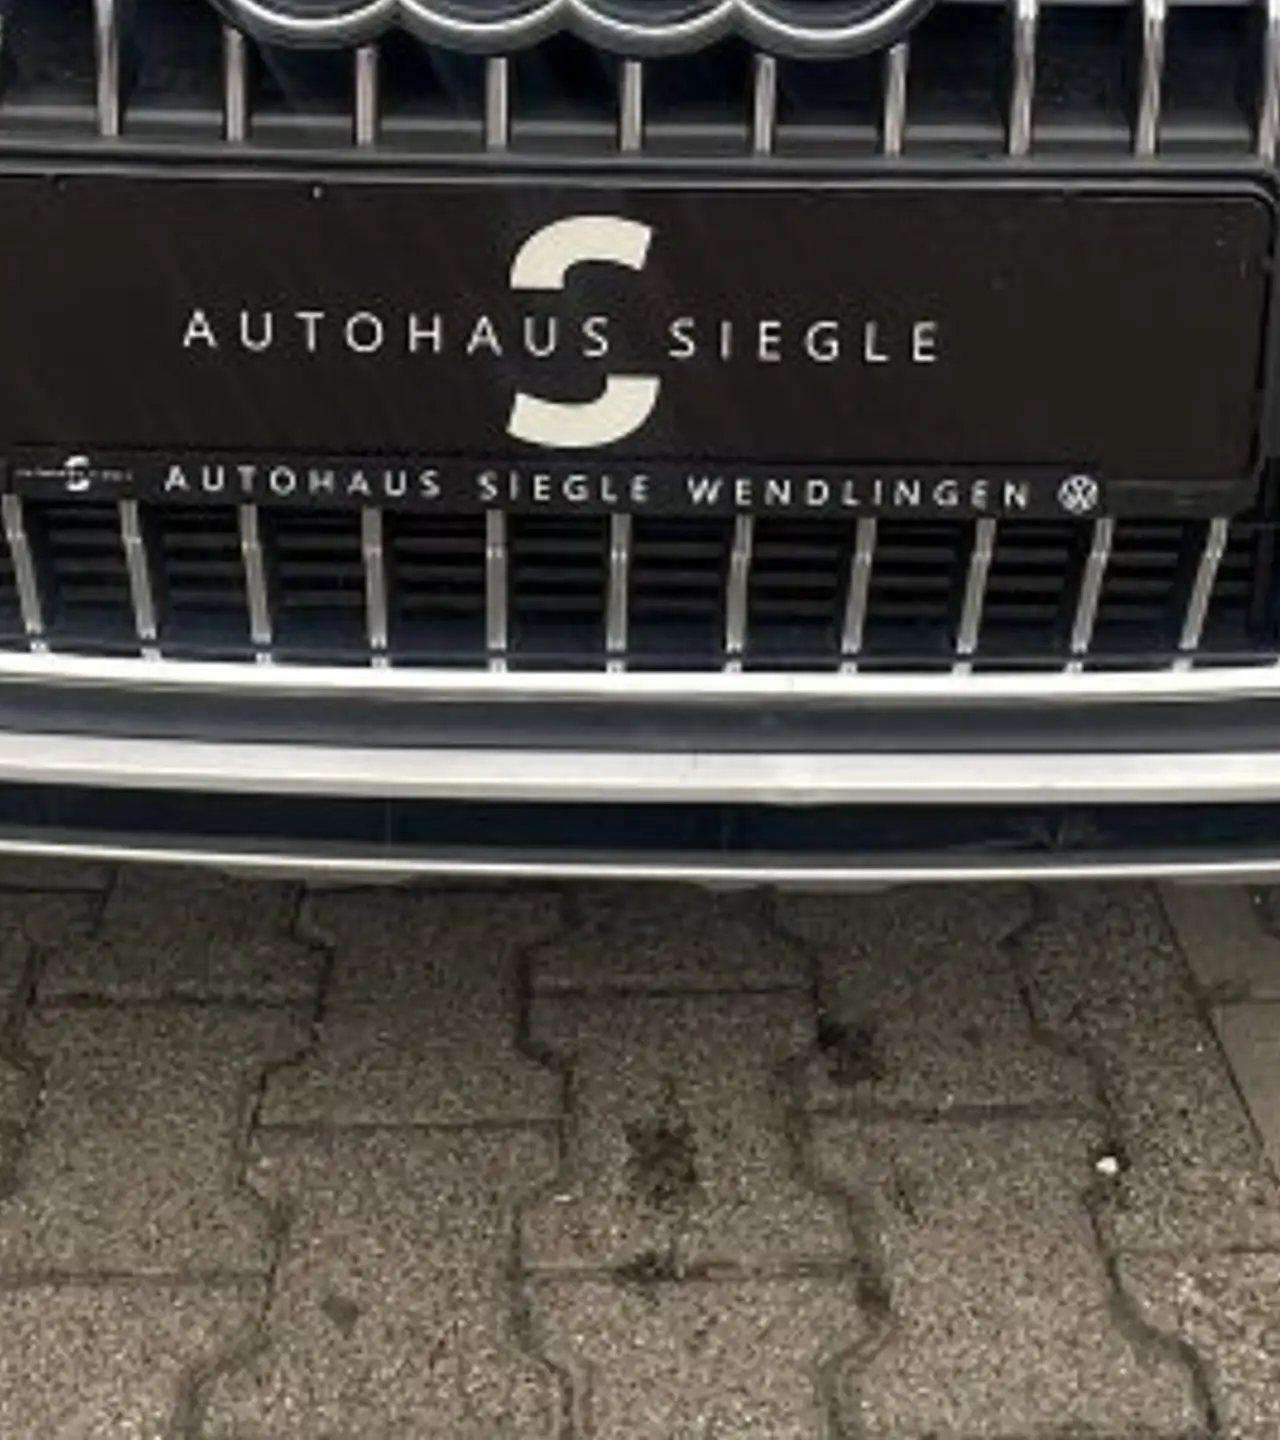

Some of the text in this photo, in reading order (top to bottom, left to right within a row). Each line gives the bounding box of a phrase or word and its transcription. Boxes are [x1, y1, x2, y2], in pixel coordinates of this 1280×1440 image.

[182, 310, 940, 363] AUTOHAUS SIEGLE
[163, 464, 441, 499] AUTOHAUS
[477, 469, 651, 503] SIEGLE
[687, 475, 1029, 511] WENDLINGEN
